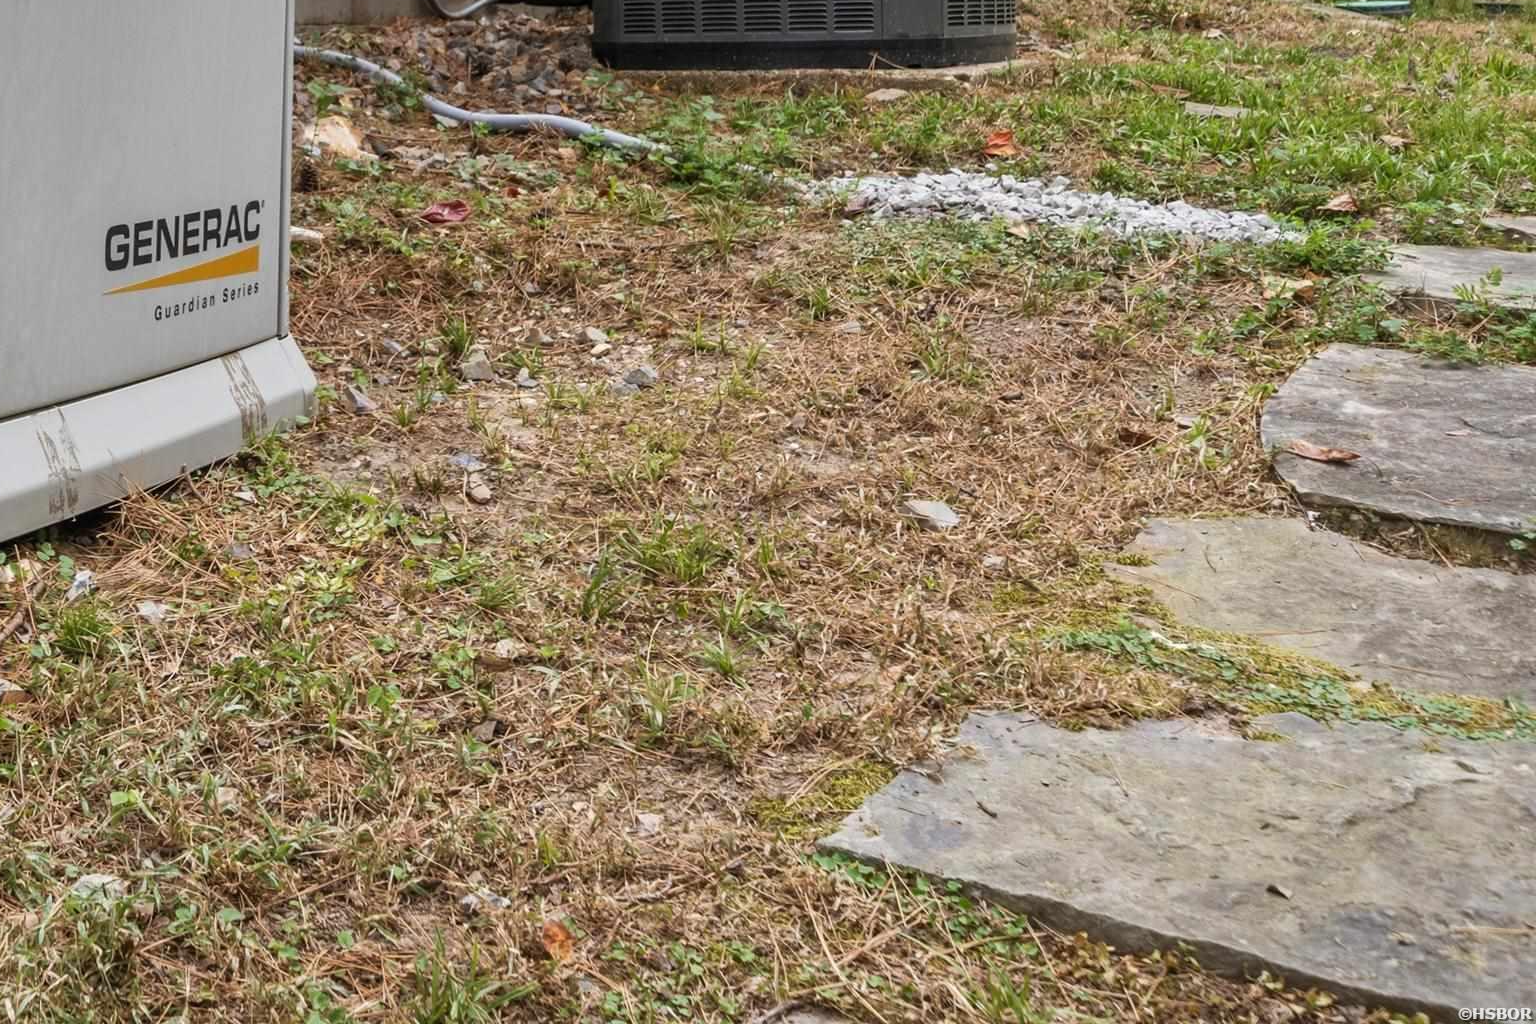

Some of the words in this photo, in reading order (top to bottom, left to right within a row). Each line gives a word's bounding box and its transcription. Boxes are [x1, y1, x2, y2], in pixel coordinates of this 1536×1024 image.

[104, 199, 261, 271] GENERAC
[154, 294, 215, 321] Guardian
[222, 282, 259, 303] Series
